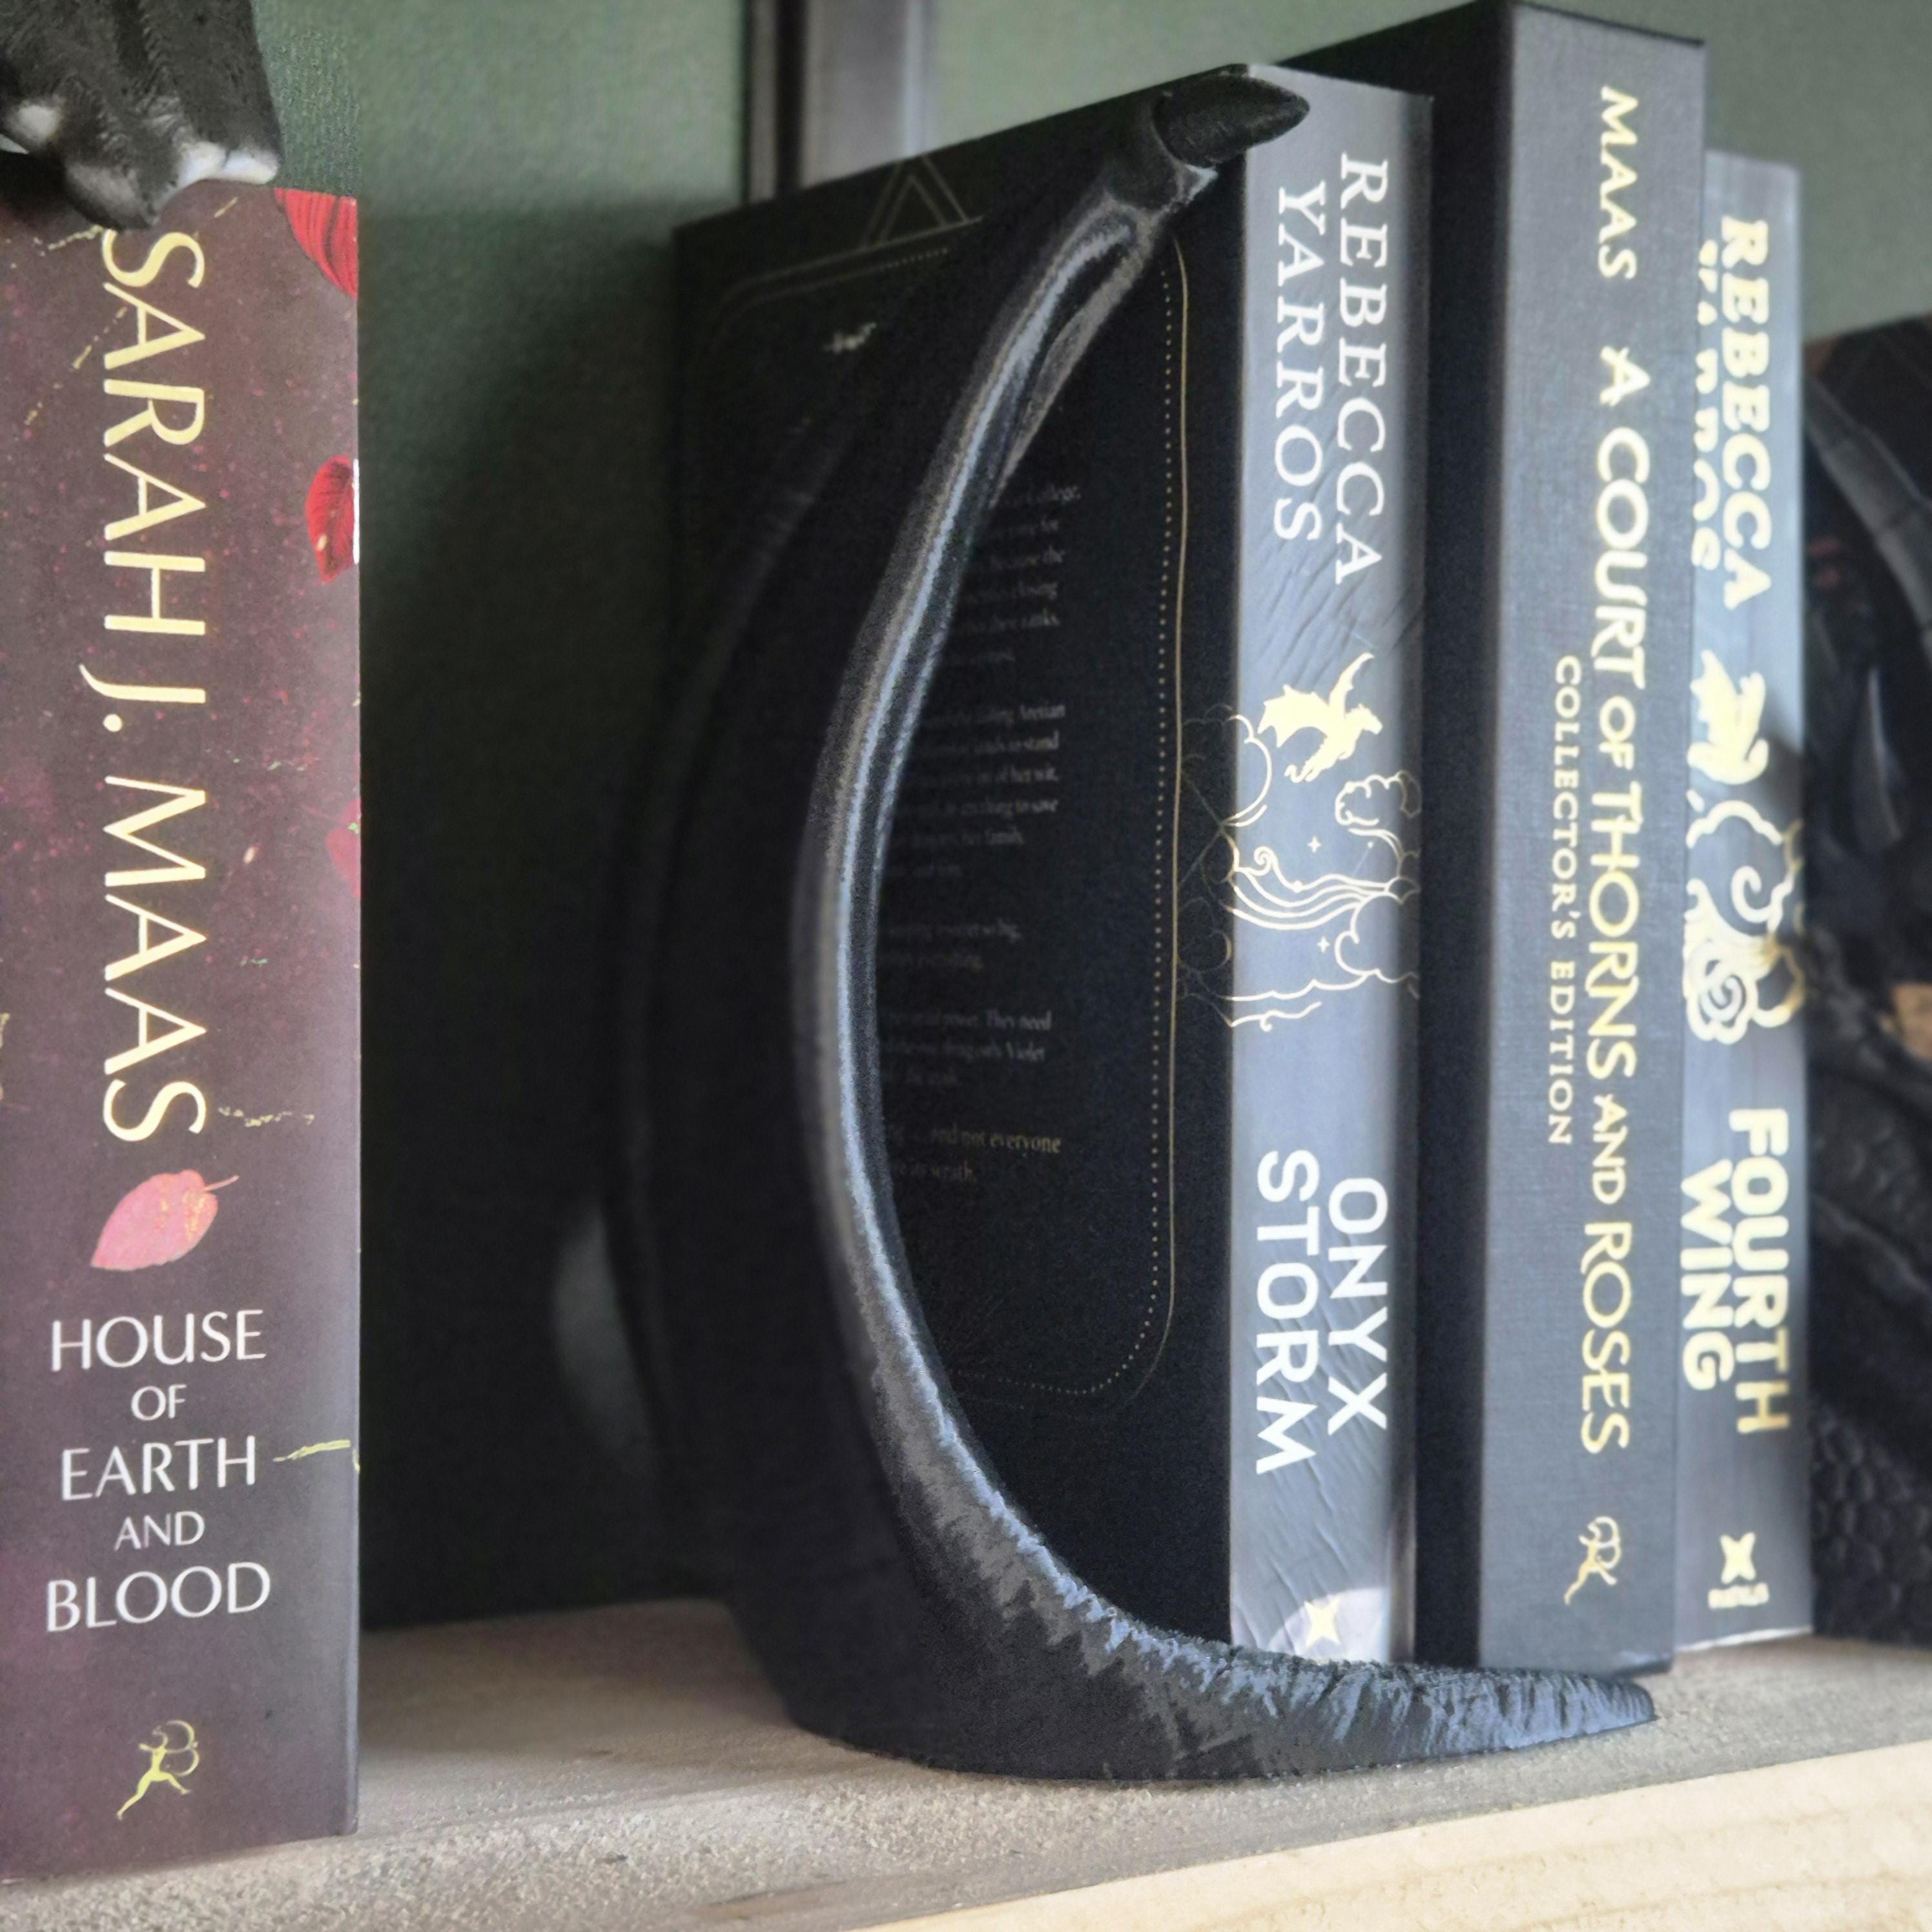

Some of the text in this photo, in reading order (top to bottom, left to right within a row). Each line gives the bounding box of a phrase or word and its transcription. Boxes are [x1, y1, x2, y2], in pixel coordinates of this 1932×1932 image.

[1598, 87, 1638, 279] MAAS
[1273, 181, 1326, 540] YARROS
[1335, 153, 1388, 585] REBECCA
[1721, 217, 1772, 609] REBECCA
[79, 229, 207, 1142] SARAH J. MAAS
[1548, 655, 1582, 1144] COLLECTOR'S EDITION
[1580, 347, 1650, 1454] A COURT OF THORNS AND ROSES
[989, 1133, 1062, 1157] everyone
[1727, 1108, 1789, 1433] FOURTH
[52, 1310, 266, 1372] HOUSE
[131, 1384, 186, 1421] OF
[1256, 1149, 1320, 1474] STORM
[1328, 1178, 1388, 1435] ONYX
[1681, 1159, 1736, 1390] WING
[62, 1435, 256, 1501] EARTH
[115, 1511, 205, 1550] AND
[47, 1562, 271, 1632] BLOOD
